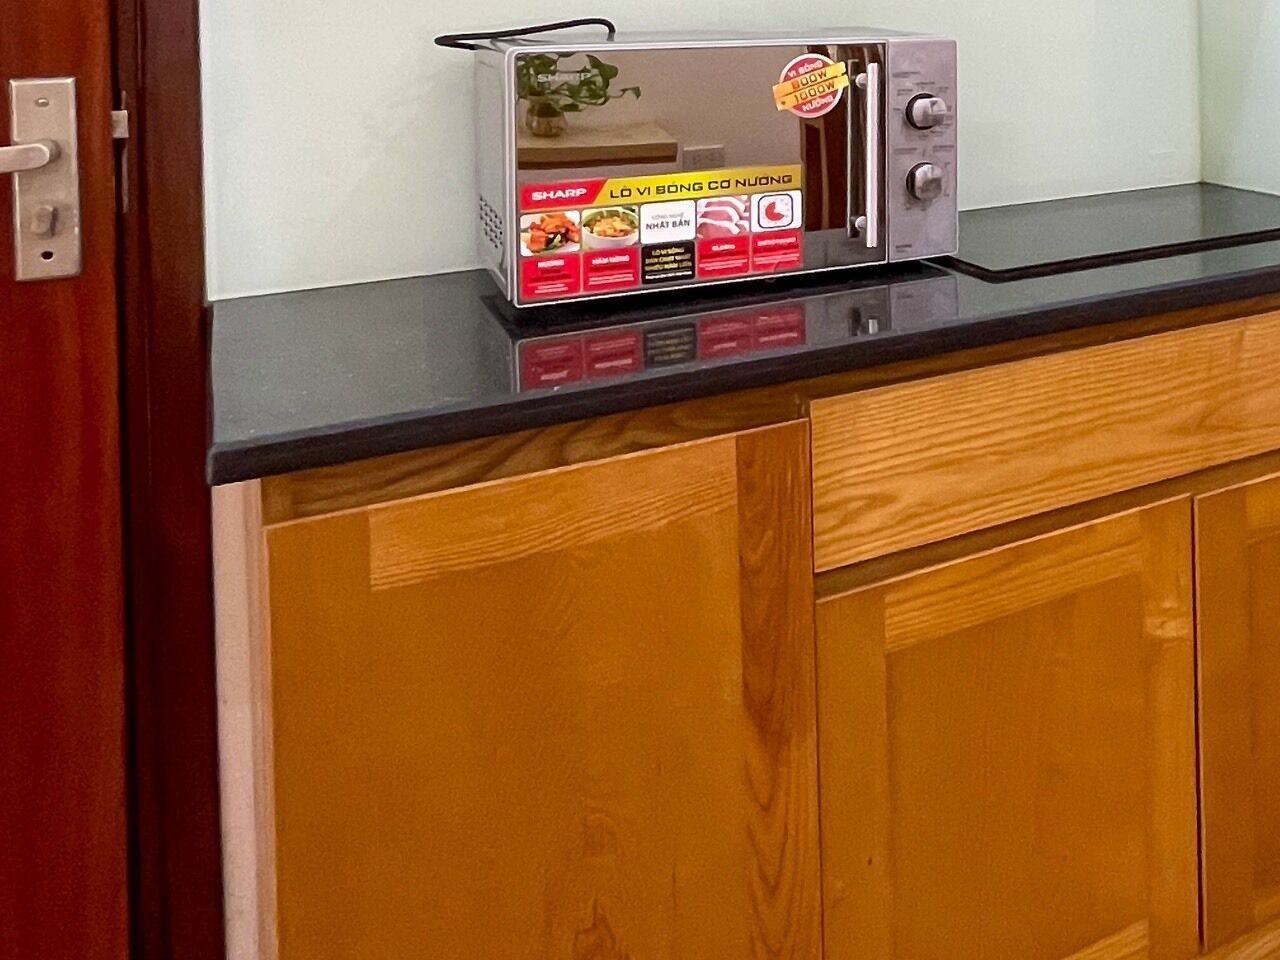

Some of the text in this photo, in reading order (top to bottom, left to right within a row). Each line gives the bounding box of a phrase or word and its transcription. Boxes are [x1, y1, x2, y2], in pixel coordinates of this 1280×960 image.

[537, 72, 592, 84] SHARP
[791, 69, 827, 90] 800W
[794, 80, 835, 103] 1000W
[531, 187, 587, 201] SHARP
[610, 185, 632, 198] LÒ
[636, 186, 651, 196] VI
[655, 181, 703, 195] SÓNG
[708, 178, 732, 190] CƠ
